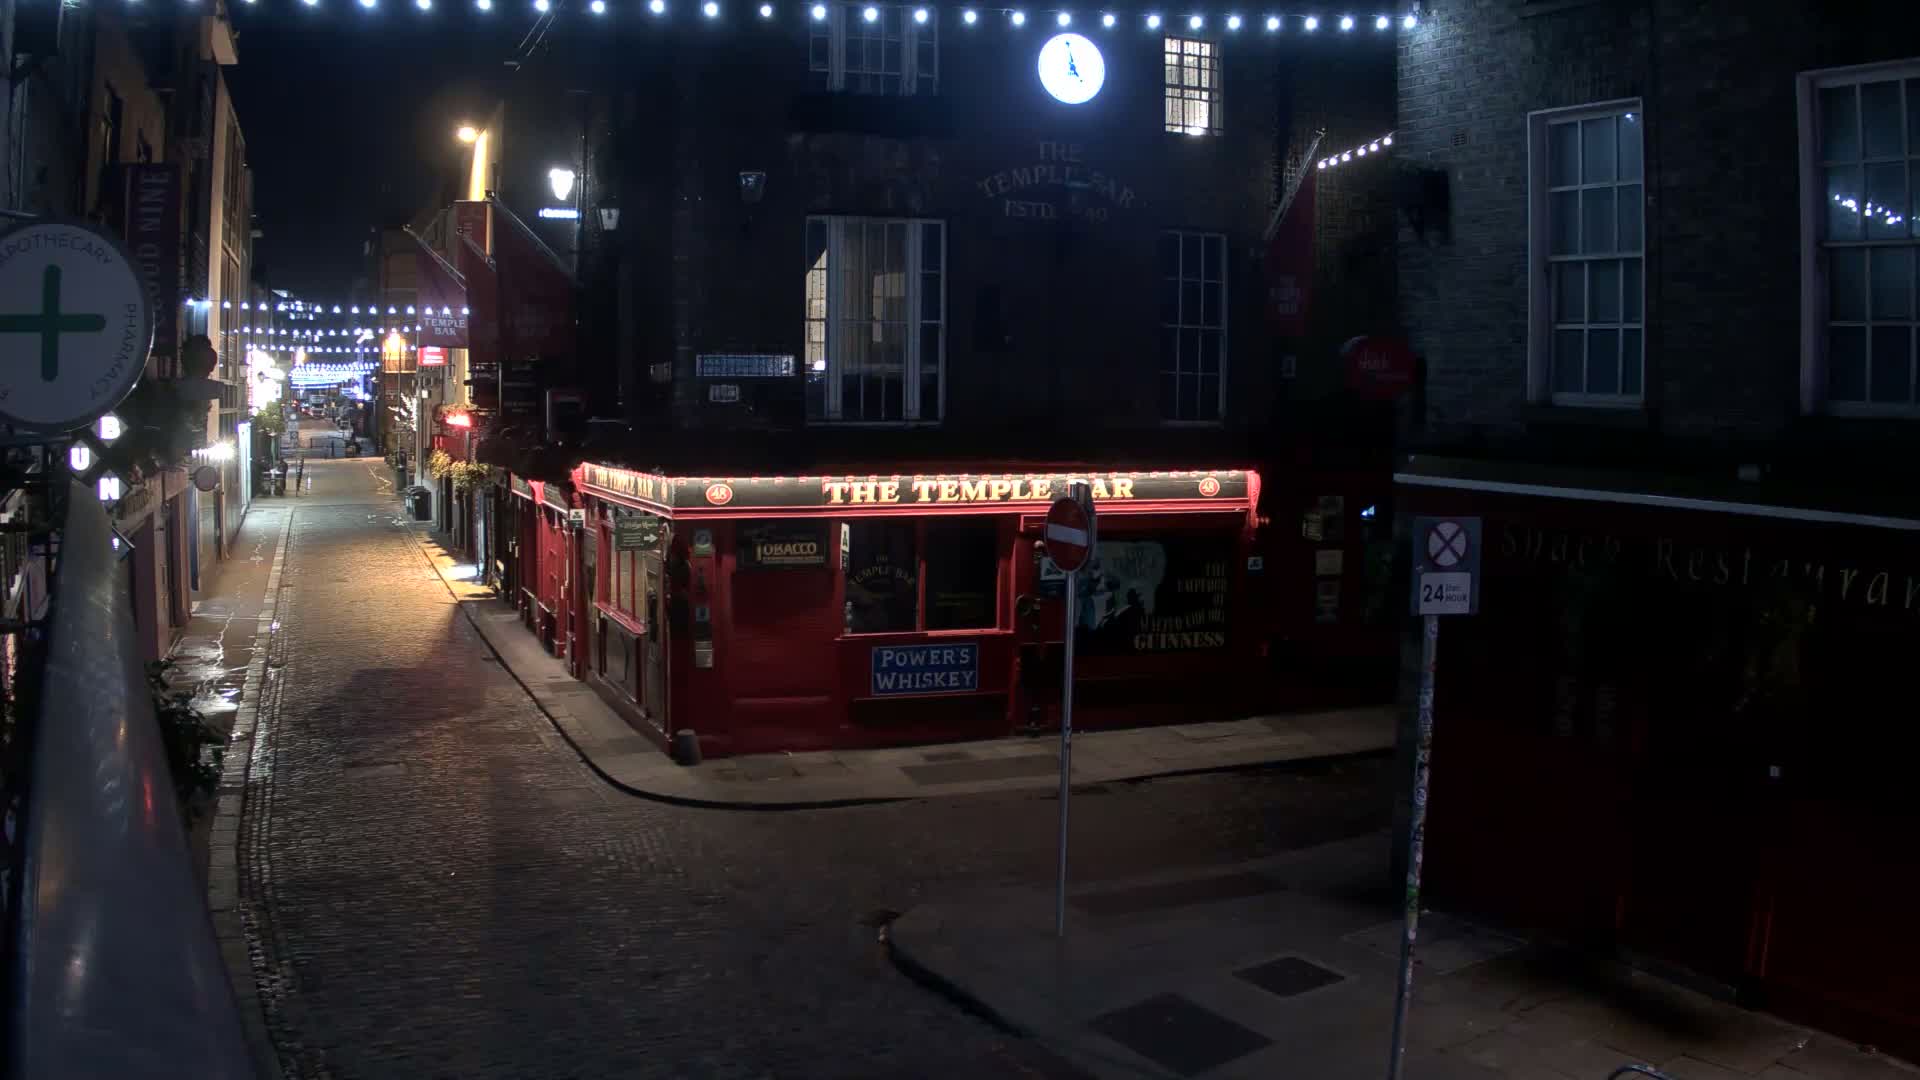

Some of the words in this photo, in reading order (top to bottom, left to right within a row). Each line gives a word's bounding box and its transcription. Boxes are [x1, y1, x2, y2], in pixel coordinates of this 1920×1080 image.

[424, 318, 466, 328] TEMPLE
[434, 327, 457, 336] BAR
[609, 470, 636, 496] TEMPLE
[637, 477, 654, 500] BAR
[711, 487, 728, 501] 48
[825, 481, 900, 504] THE
[913, 478, 1052, 503] TEMPLE
[756, 541, 817, 561] TOBACCO
[1424, 584, 1444, 602] 24
[1133, 631, 1225, 650] GUINNESS
[876, 671, 974, 690] WHISKEY
